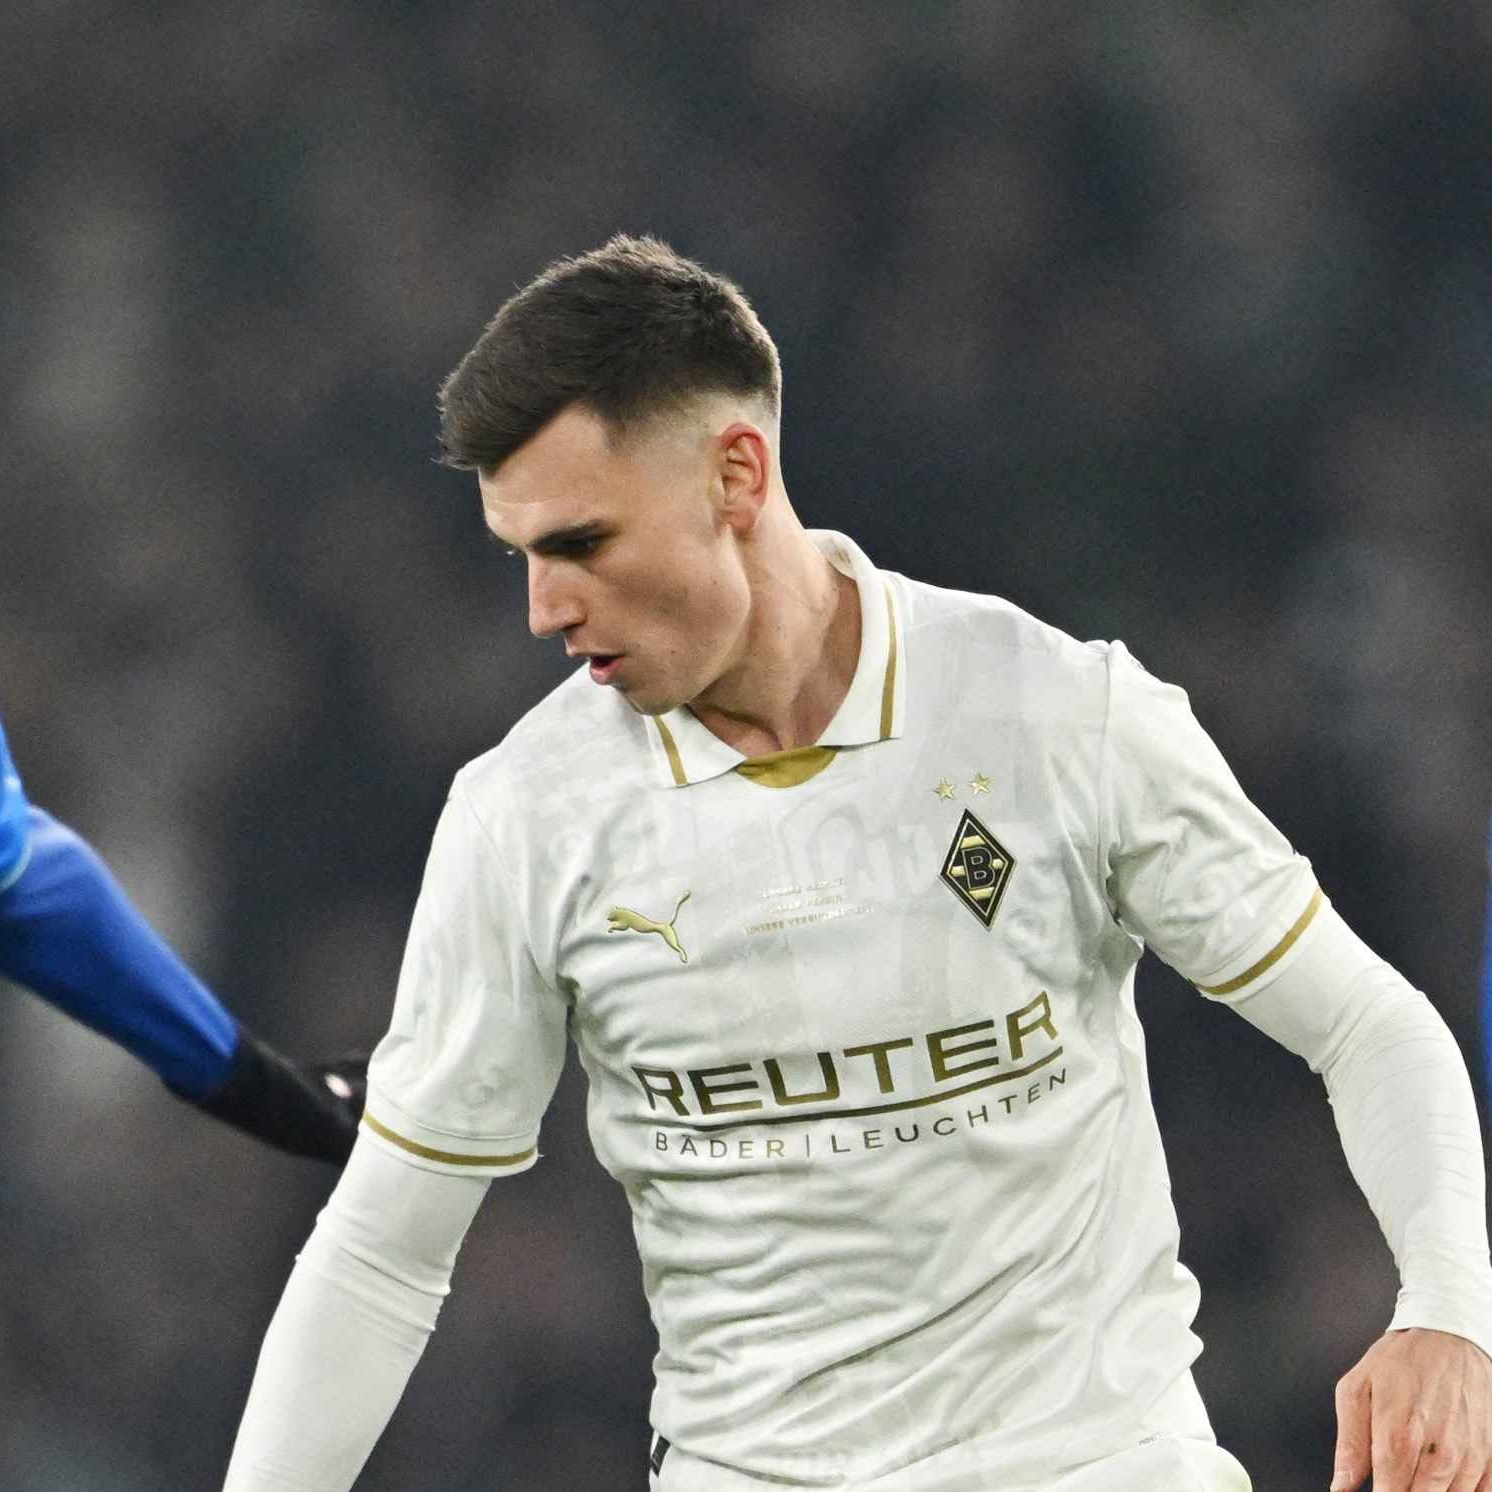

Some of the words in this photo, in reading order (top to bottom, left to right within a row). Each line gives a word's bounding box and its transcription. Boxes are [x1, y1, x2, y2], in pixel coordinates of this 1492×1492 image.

[631, 990, 1059, 1117] REUTER
[655, 1131, 785, 1159] BÄDER
[831, 1068, 1067, 1154] LEUCHTEN
